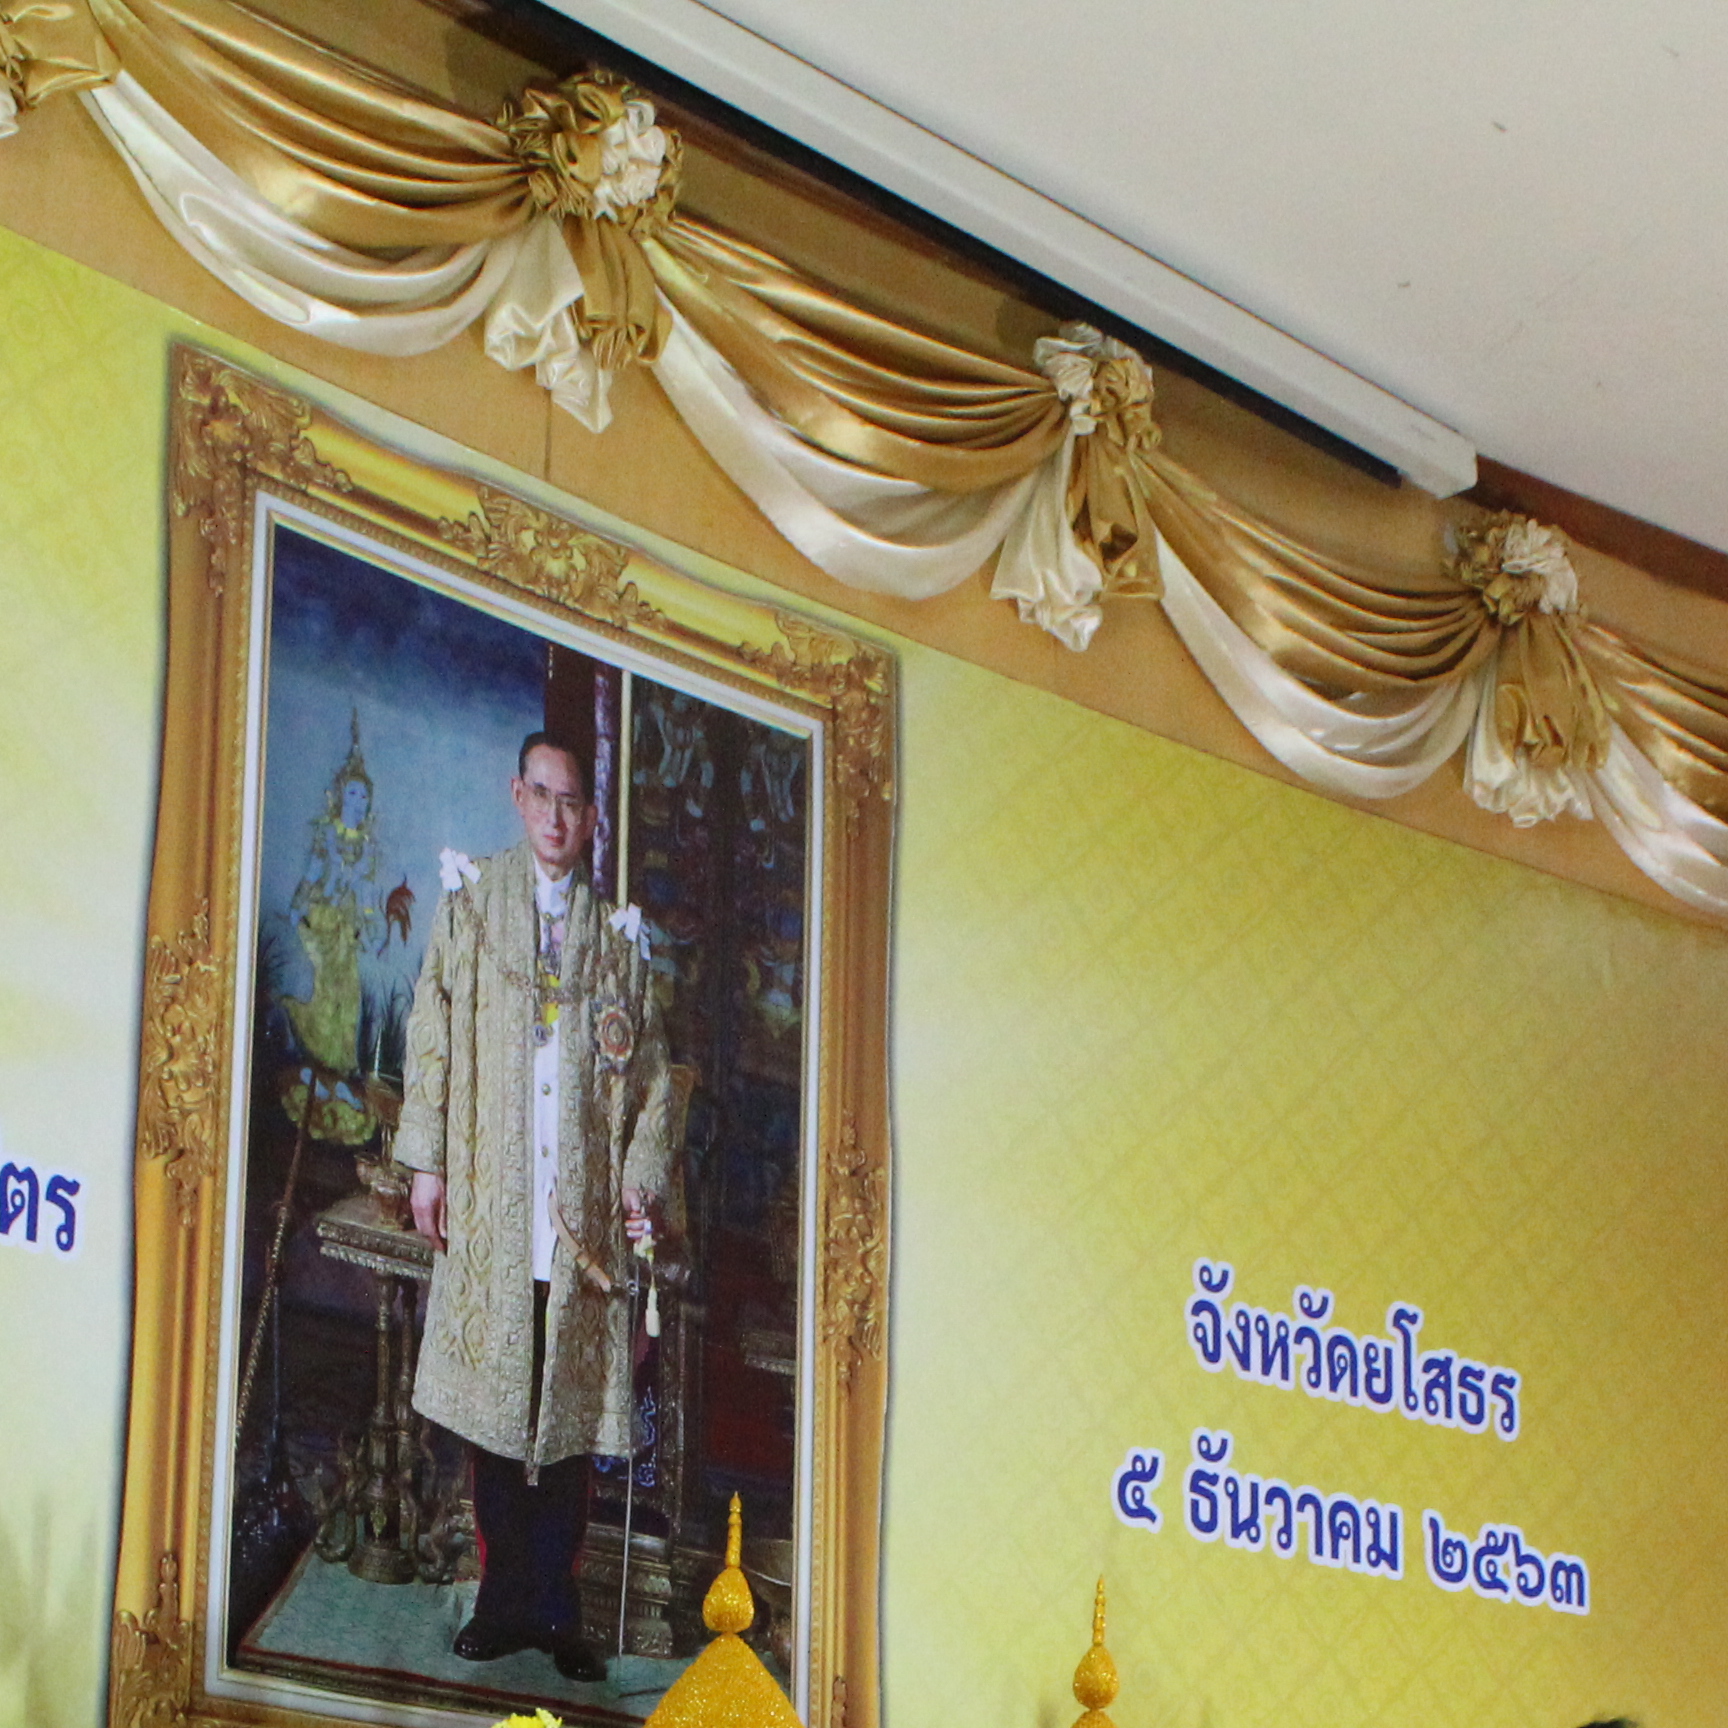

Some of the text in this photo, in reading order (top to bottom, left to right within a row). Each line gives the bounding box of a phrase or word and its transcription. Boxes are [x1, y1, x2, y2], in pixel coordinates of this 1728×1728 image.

[1188, 1263, 1519, 1436] จังหวัดยโสธร
[1115, 1433, 1588, 1609] ๕ ธันวาคม ๒๕๖๓
